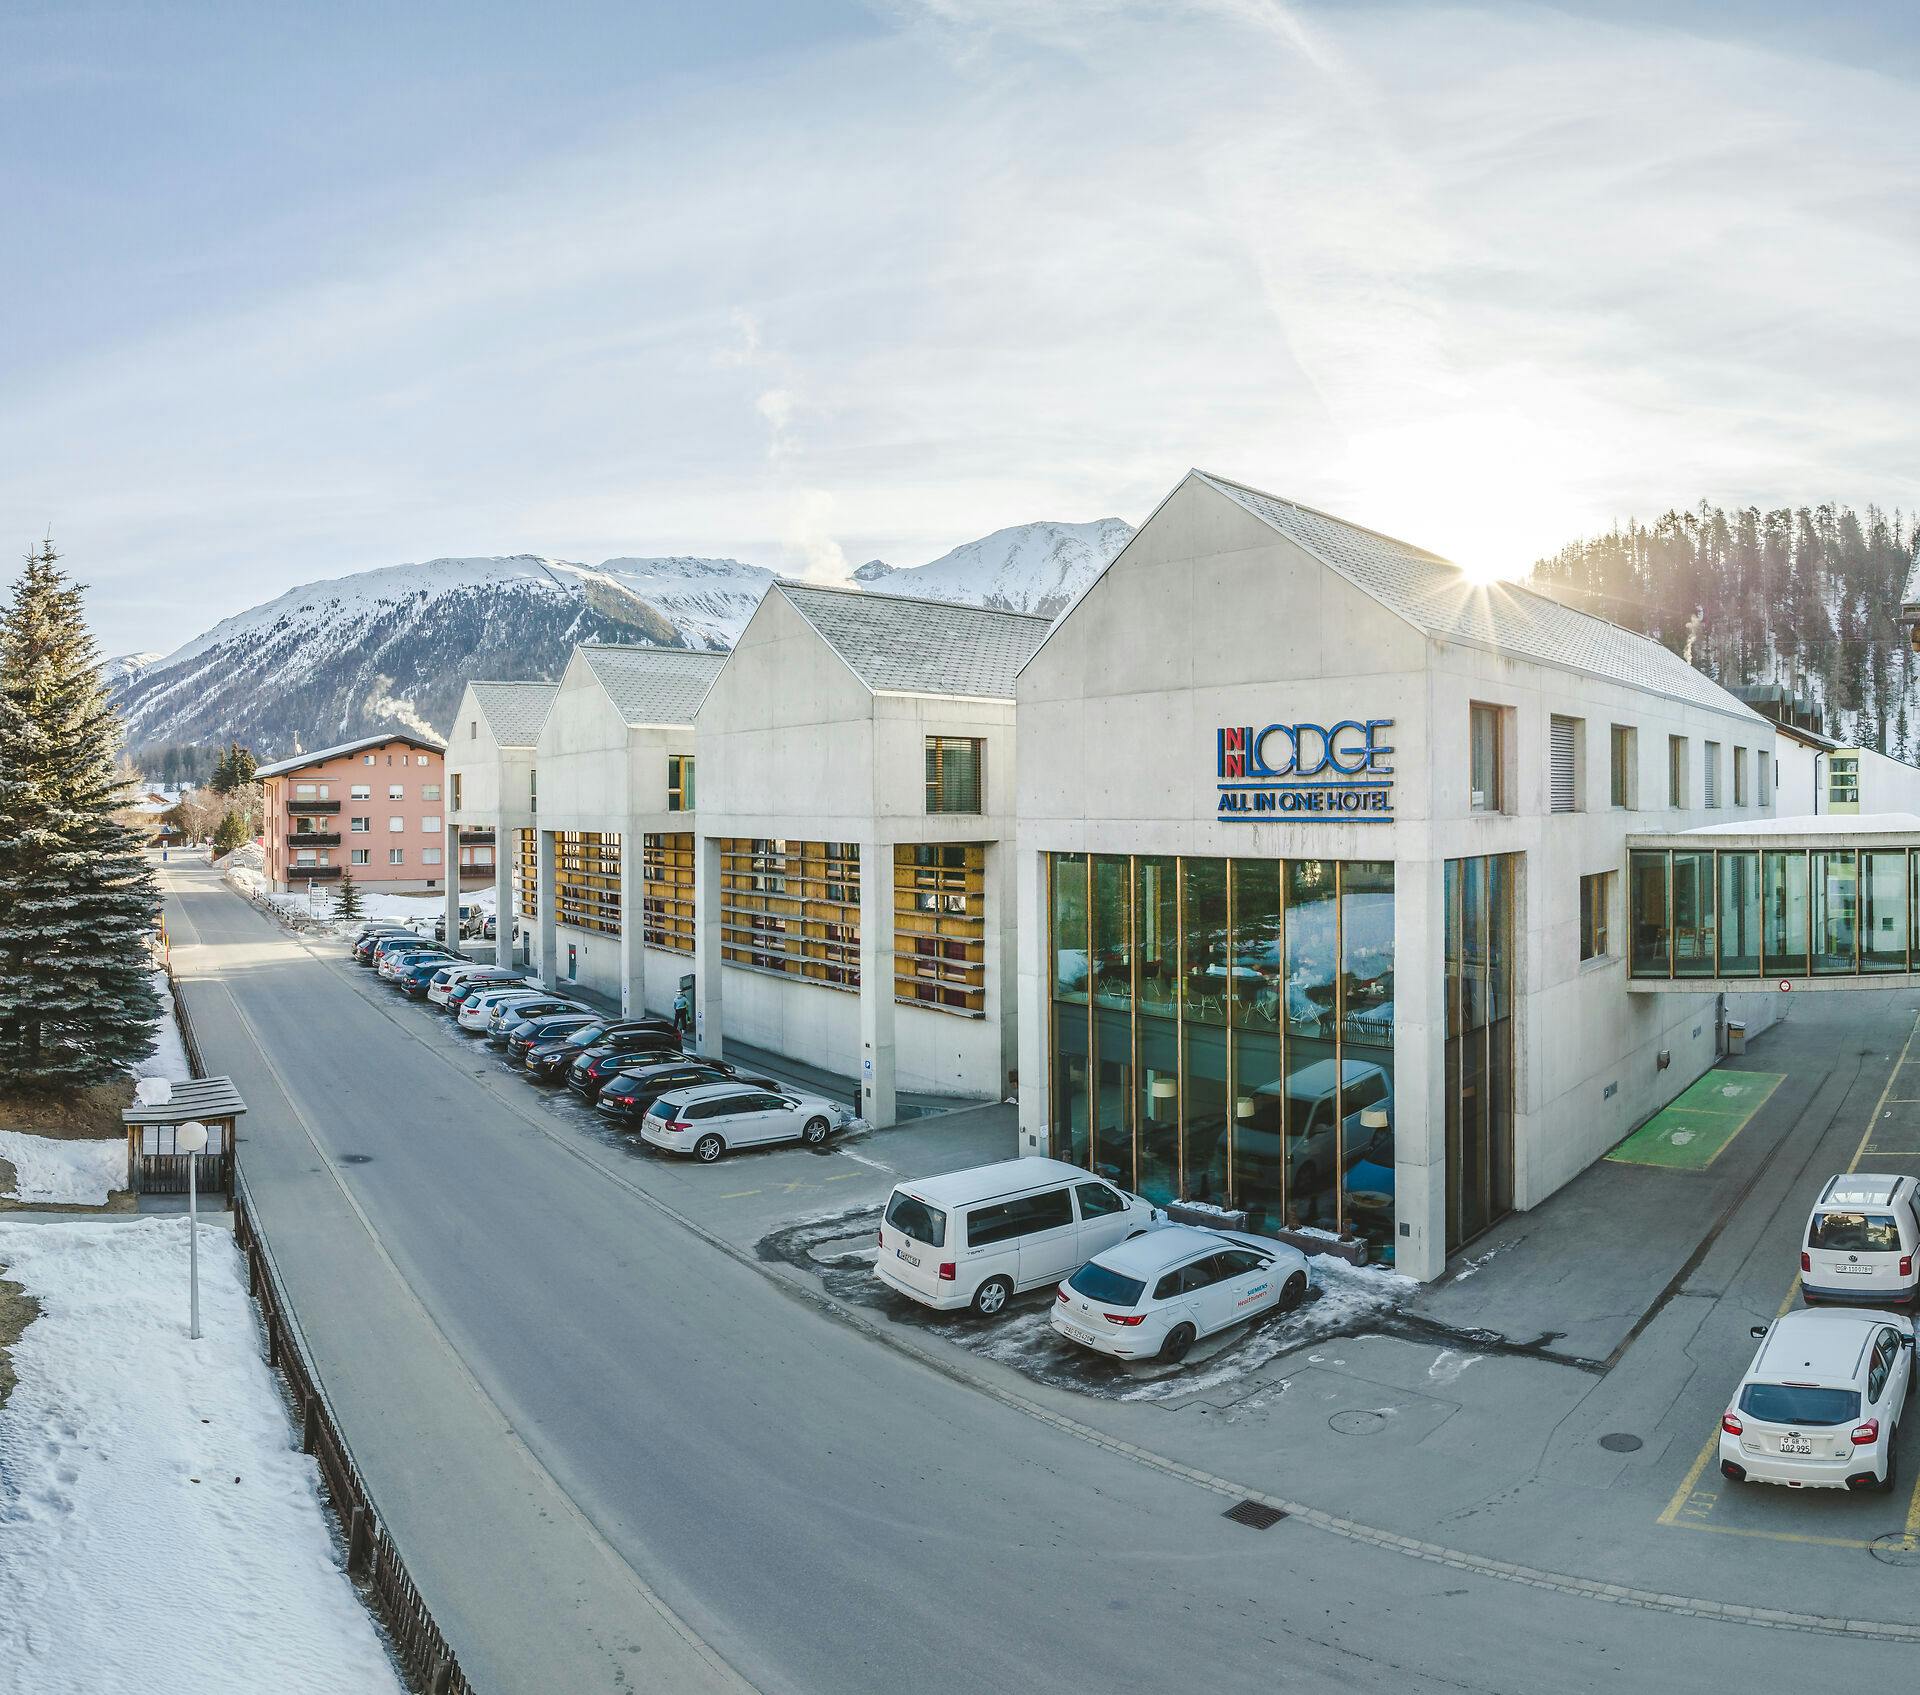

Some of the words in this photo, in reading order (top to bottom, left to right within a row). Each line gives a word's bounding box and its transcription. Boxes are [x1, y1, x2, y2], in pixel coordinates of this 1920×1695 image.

[1217, 793, 1251, 811] ALL
[1253, 792, 1276, 811] IN
[1278, 791, 1324, 811] ONE
[1326, 791, 1394, 811] HOTEL
[1247, 1282, 1268, 1296] SIEMENS
